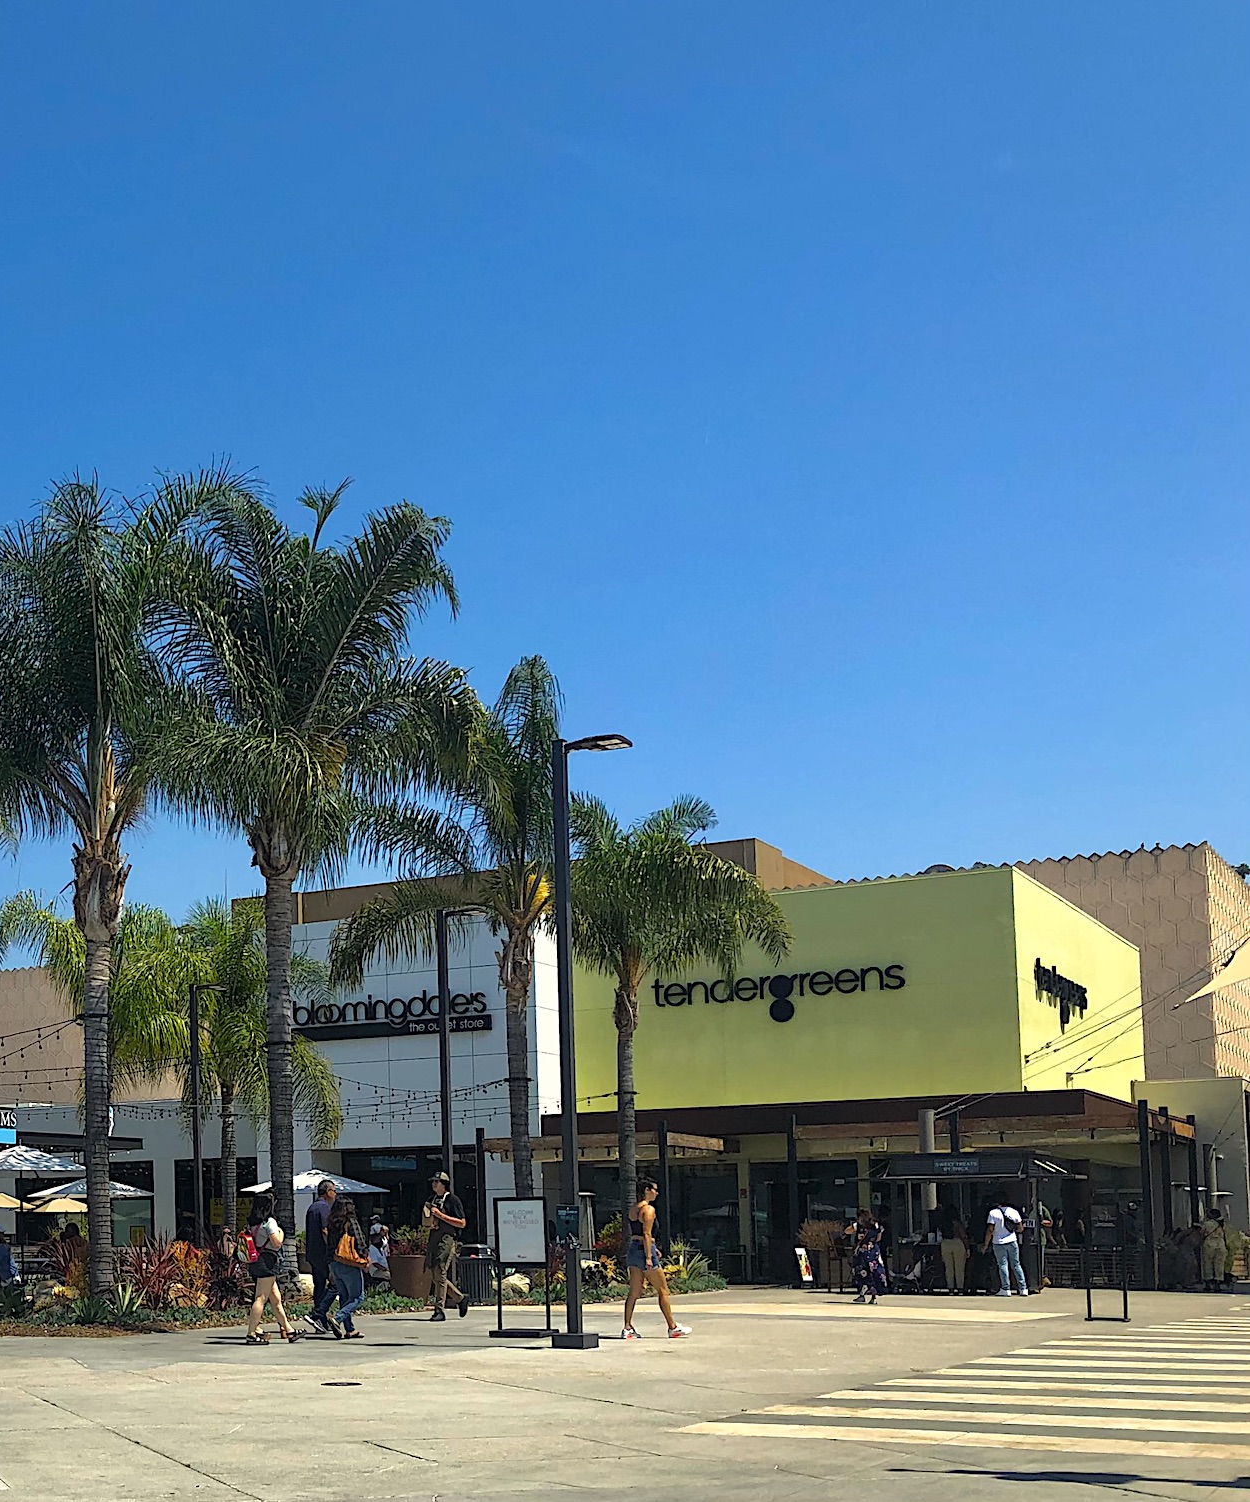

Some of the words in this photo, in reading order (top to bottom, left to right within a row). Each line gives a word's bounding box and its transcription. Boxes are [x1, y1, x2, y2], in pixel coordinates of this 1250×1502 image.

[292, 989, 487, 1028] bloomingdae's
[409, 1022, 425, 1032] the
[428, 1019, 456, 1031] ouet
[459, 1018, 484, 1029] store
